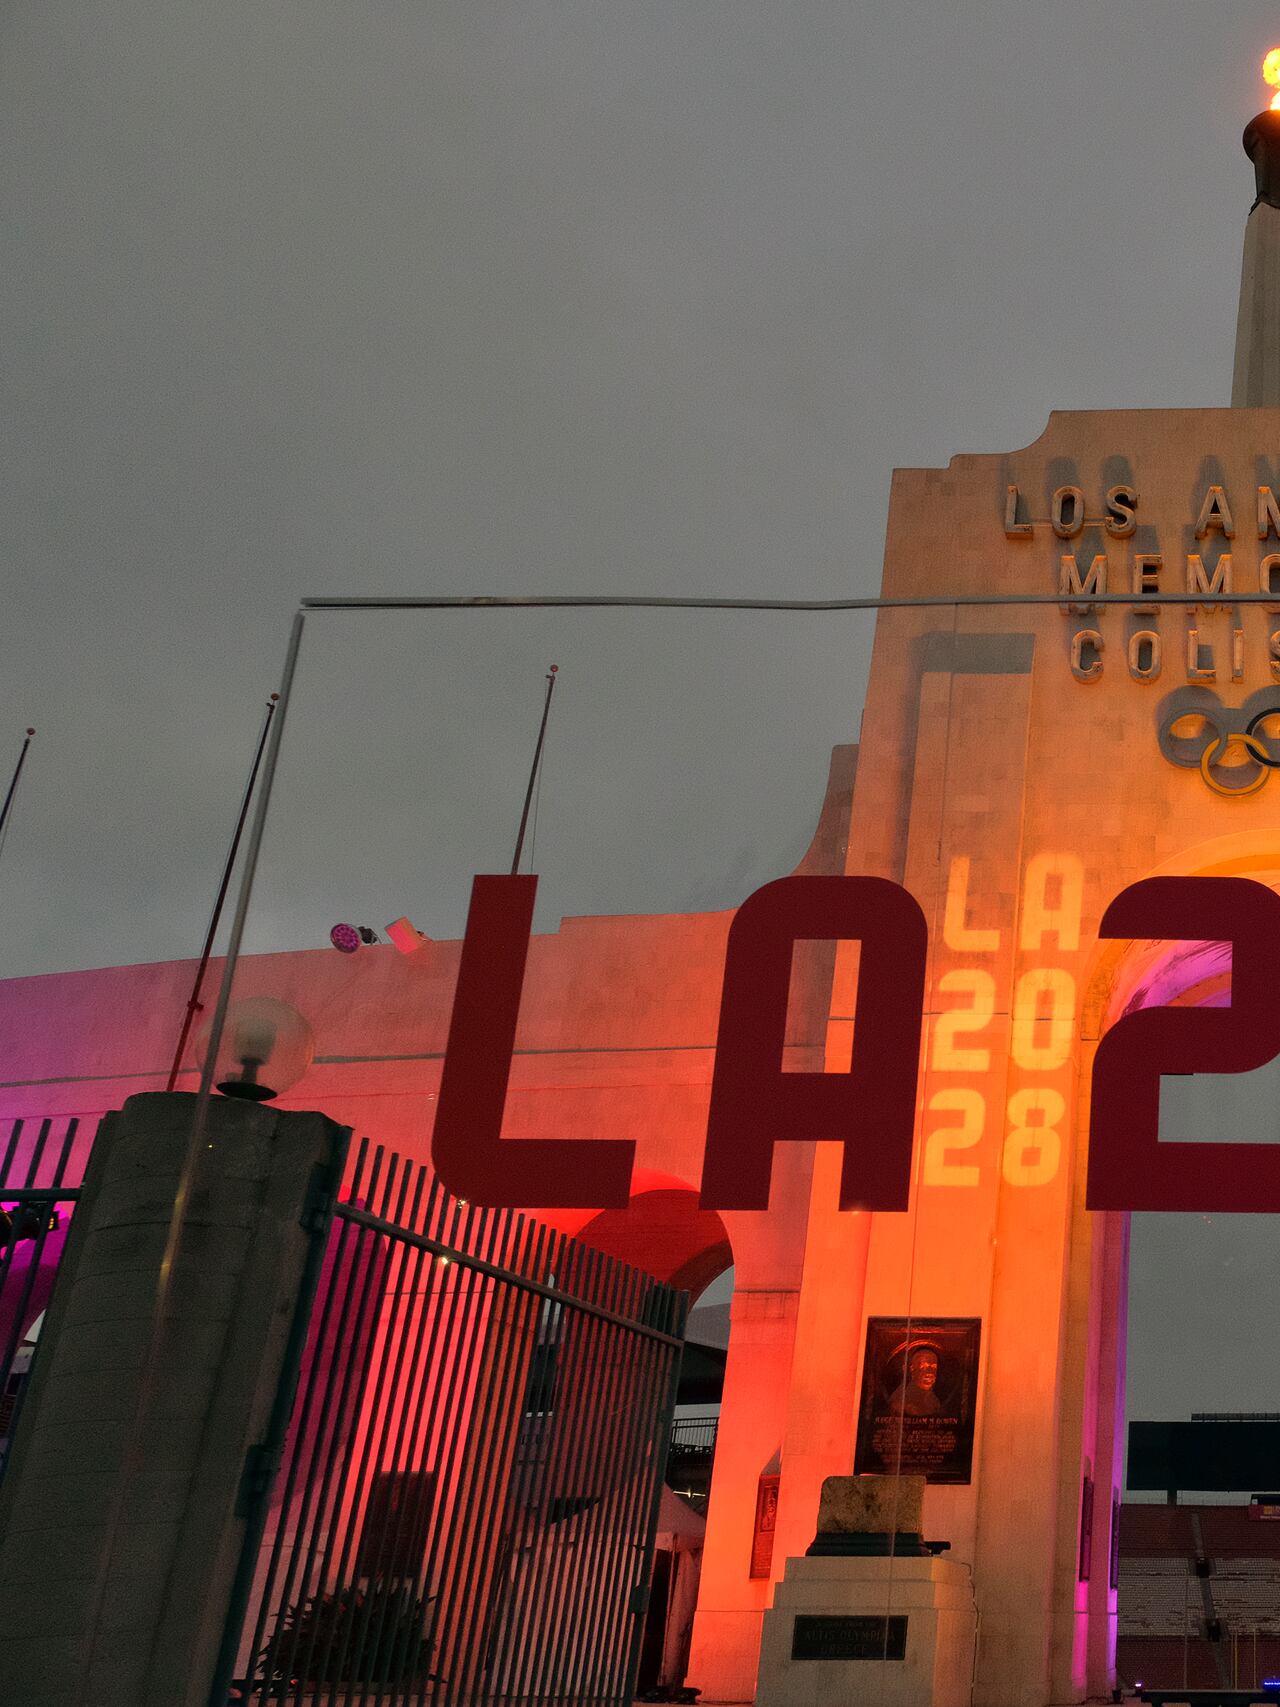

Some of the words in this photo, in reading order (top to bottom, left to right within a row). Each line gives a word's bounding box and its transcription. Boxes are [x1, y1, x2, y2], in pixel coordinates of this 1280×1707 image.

[1004, 485, 1137, 538] LOS
[943, 853, 1082, 952] LA
[431, 874, 928, 1213] LA
[934, 968, 1076, 1072] 20
[925, 1088, 1065, 1187] 28
